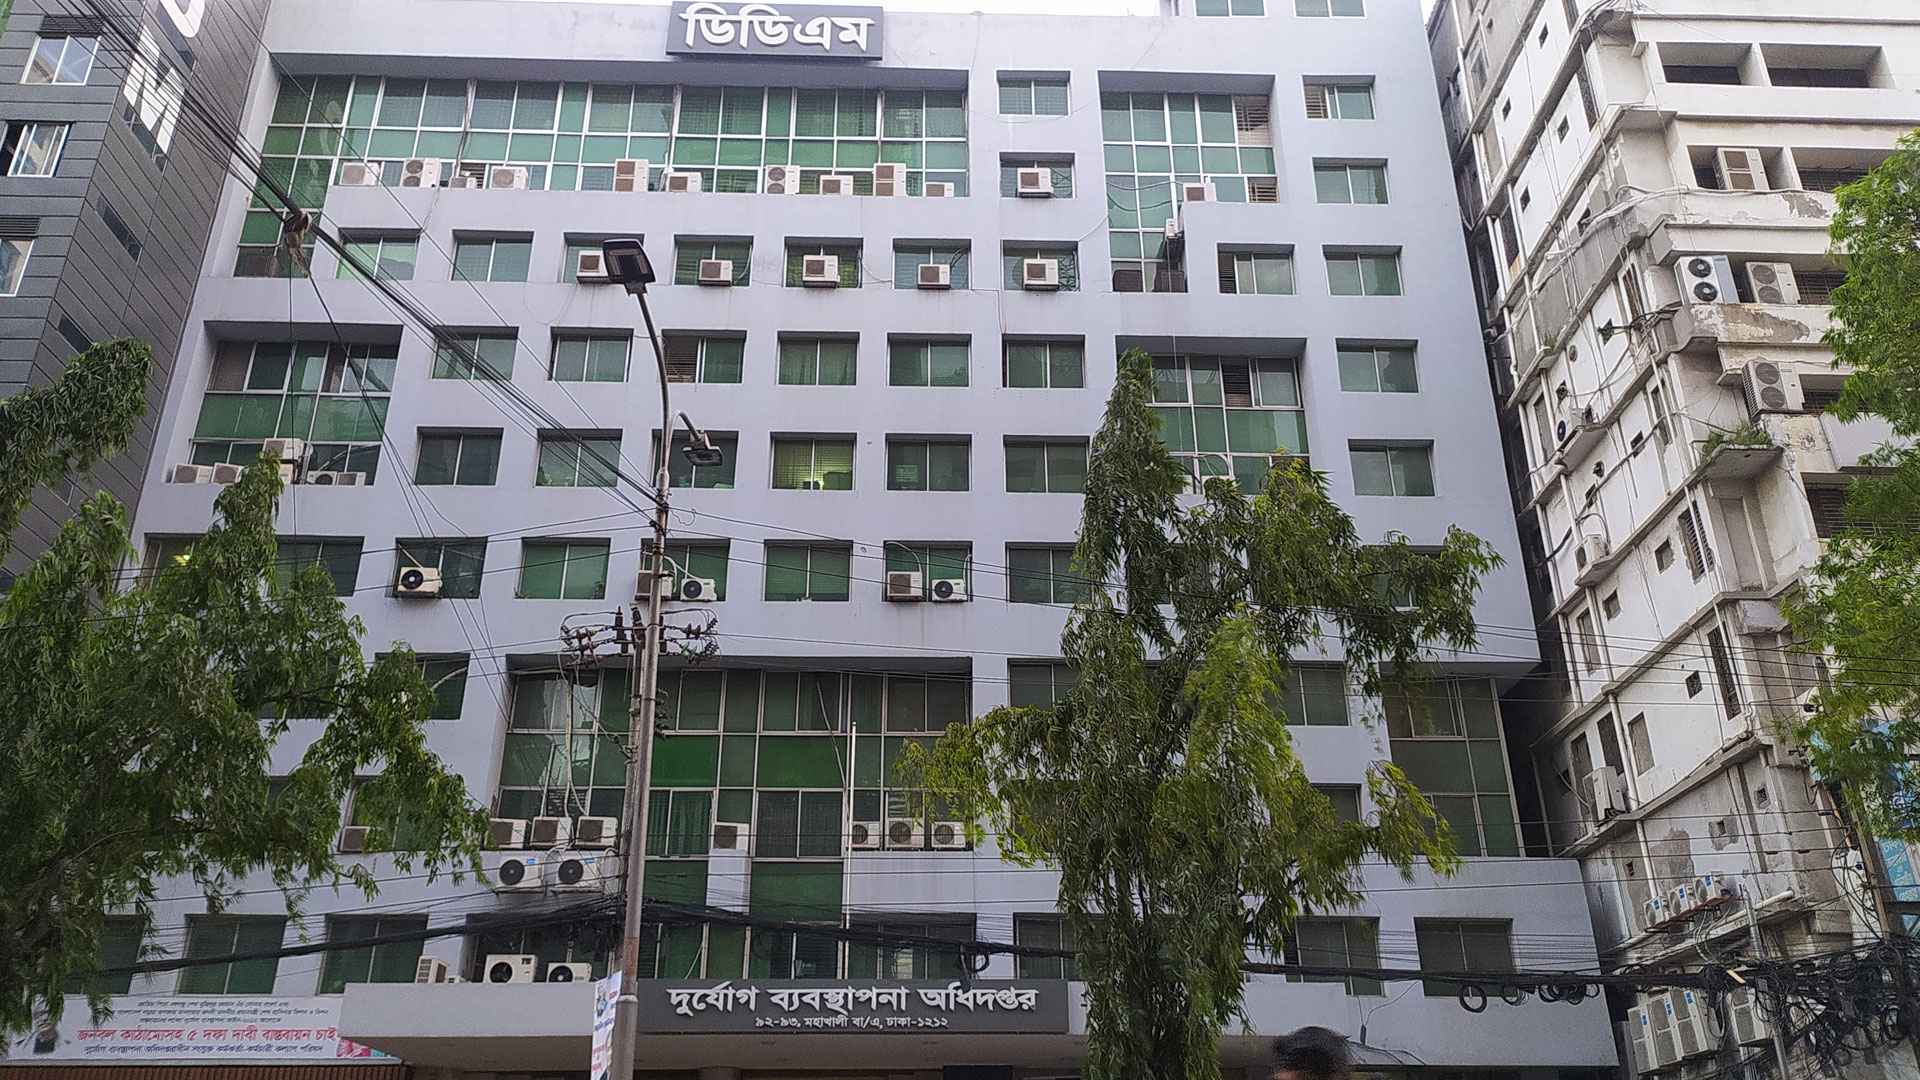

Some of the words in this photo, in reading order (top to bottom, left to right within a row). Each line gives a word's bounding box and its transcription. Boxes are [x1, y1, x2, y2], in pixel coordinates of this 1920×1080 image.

[679, 2, 875, 51] ডিডিএম
[666, 981, 760, 1016] দুর্যোগ
[767, 985, 910, 1016] ব্যবস্থাপনা
[917, 981, 1039, 1011] অধিদপ্তর
[803, 1014, 848, 1028] মহাখালী
